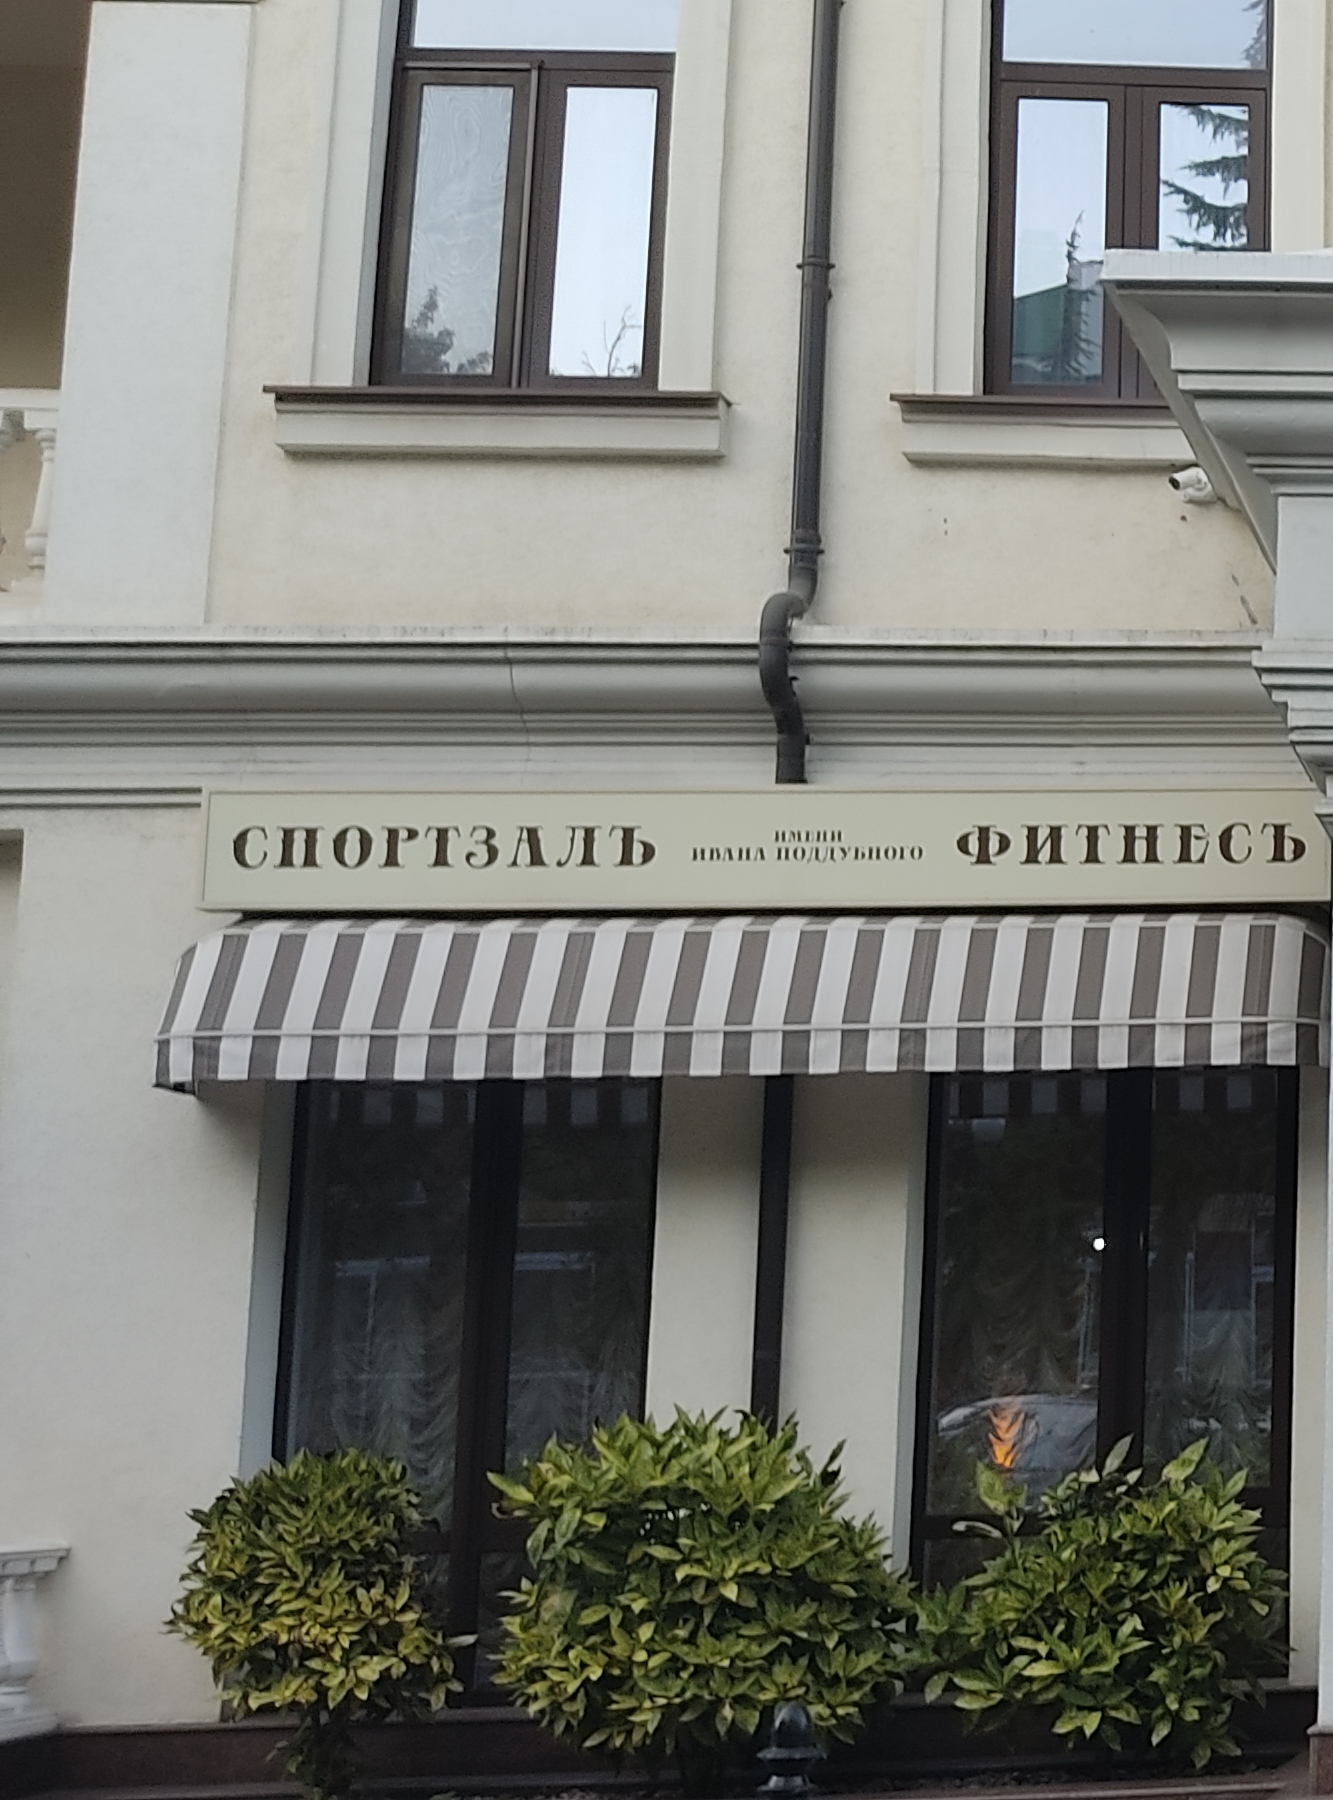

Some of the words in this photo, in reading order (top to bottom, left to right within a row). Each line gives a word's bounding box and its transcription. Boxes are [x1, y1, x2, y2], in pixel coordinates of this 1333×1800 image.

[232, 825, 656, 869] СПОРТЗАЛЪ
[774, 829, 842, 842] ИМЕНИ
[956, 821, 1307, 866] ФИТНЕСЪ
[691, 847, 766, 861] ИВАНА
[776, 845, 924, 864] ПОДДУБНОГО
